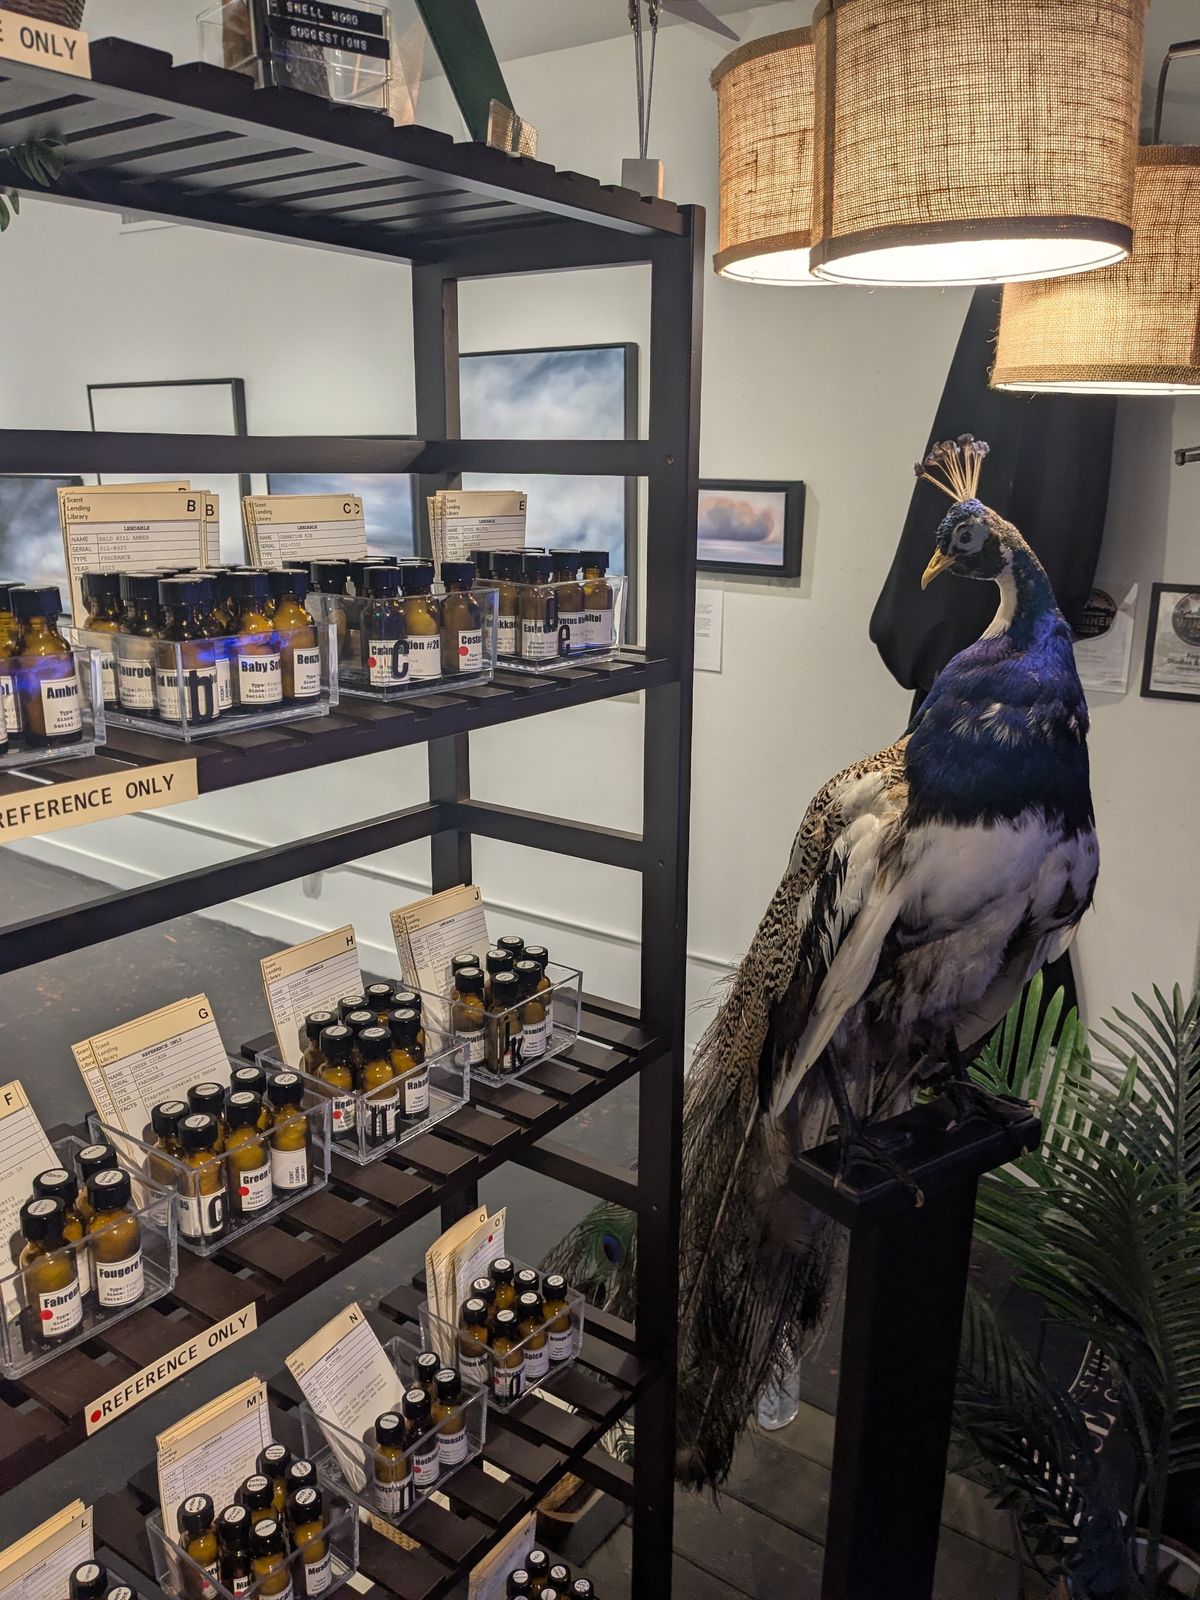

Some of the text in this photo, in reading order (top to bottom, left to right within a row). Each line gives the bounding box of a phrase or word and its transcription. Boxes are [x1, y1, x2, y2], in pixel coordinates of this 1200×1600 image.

[286, 2, 358, 25] SMELL WORD
[290, 25, 368, 51] SUGGESTIONS
[20, 27, 77, 61] ONLY
[187, 500, 196, 512] B
[343, 503, 351, 514] C
[519, 501, 525, 510] E
[241, 660, 268, 673] Baby
[125, 773, 174, 800] ONLY
[474, 891, 479, 901] J
[345, 935, 354, 946] H
[198, 1008, 209, 1019] G
[97, 1045, 118, 1057] Lending
[79, 1053, 93, 1062] Lend
[100, 1053, 118, 1063] Library
[81, 1060, 95, 1069] Libra
[108, 1070, 124, 1081] NAME
[92, 1078, 102, 1086] NAM
[111, 1078, 130, 1089] SERIAL
[94, 1085, 105, 1094] SER
[114, 1088, 128, 1097] TYPE
[4, 1092, 13, 1106] F
[98, 1093, 108, 1101] TYP
[117, 1095, 131, 1104] YEAR
[102, 1101, 112, 1109] YEA
[120, 1103, 138, 1113] FACTS
[105, 1108, 117, 1116] FAC
[242, 1172, 269, 1185] Green
[349, 1312, 358, 1324] N
[101, 1313, 248, 1417] REFERENCE ONLY
[246, 1396, 257, 1408] M
[81, 1519, 88, 1528] L
